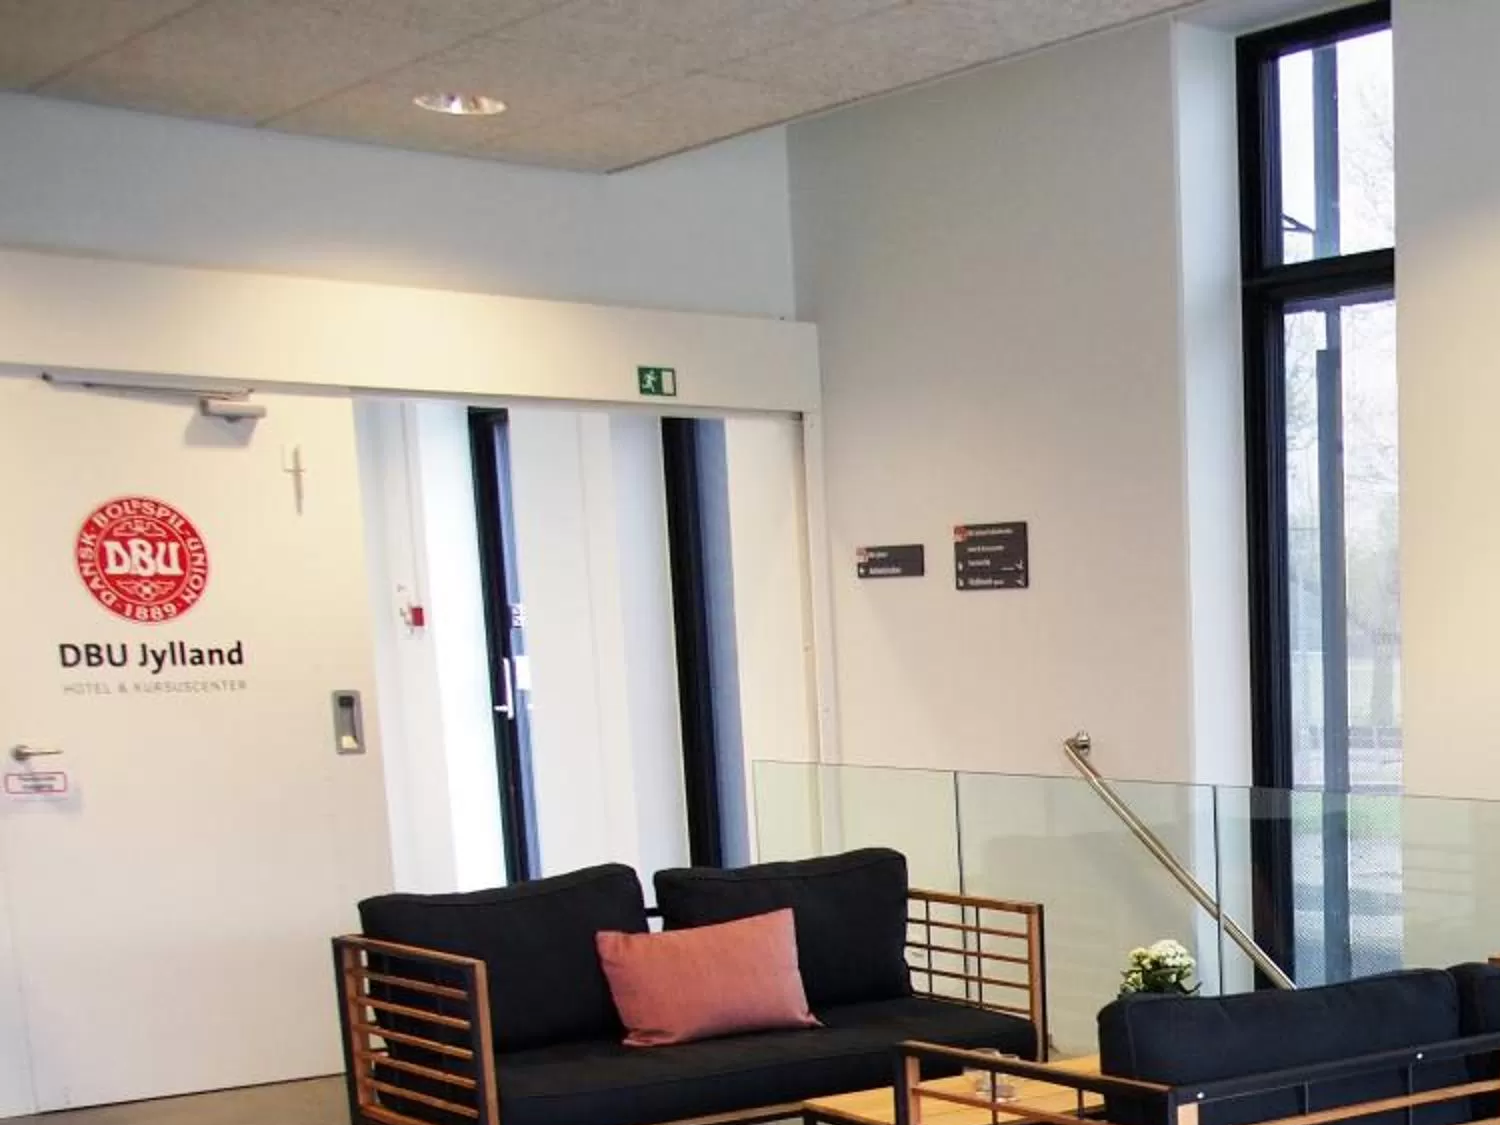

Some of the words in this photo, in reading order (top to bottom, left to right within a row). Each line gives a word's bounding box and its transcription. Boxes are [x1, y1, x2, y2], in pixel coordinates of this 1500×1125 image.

[103, 538, 184, 577] DBU
[124, 602, 177, 620] 1889
[58, 643, 128, 668] DBU
[138, 640, 244, 675] Jylland
